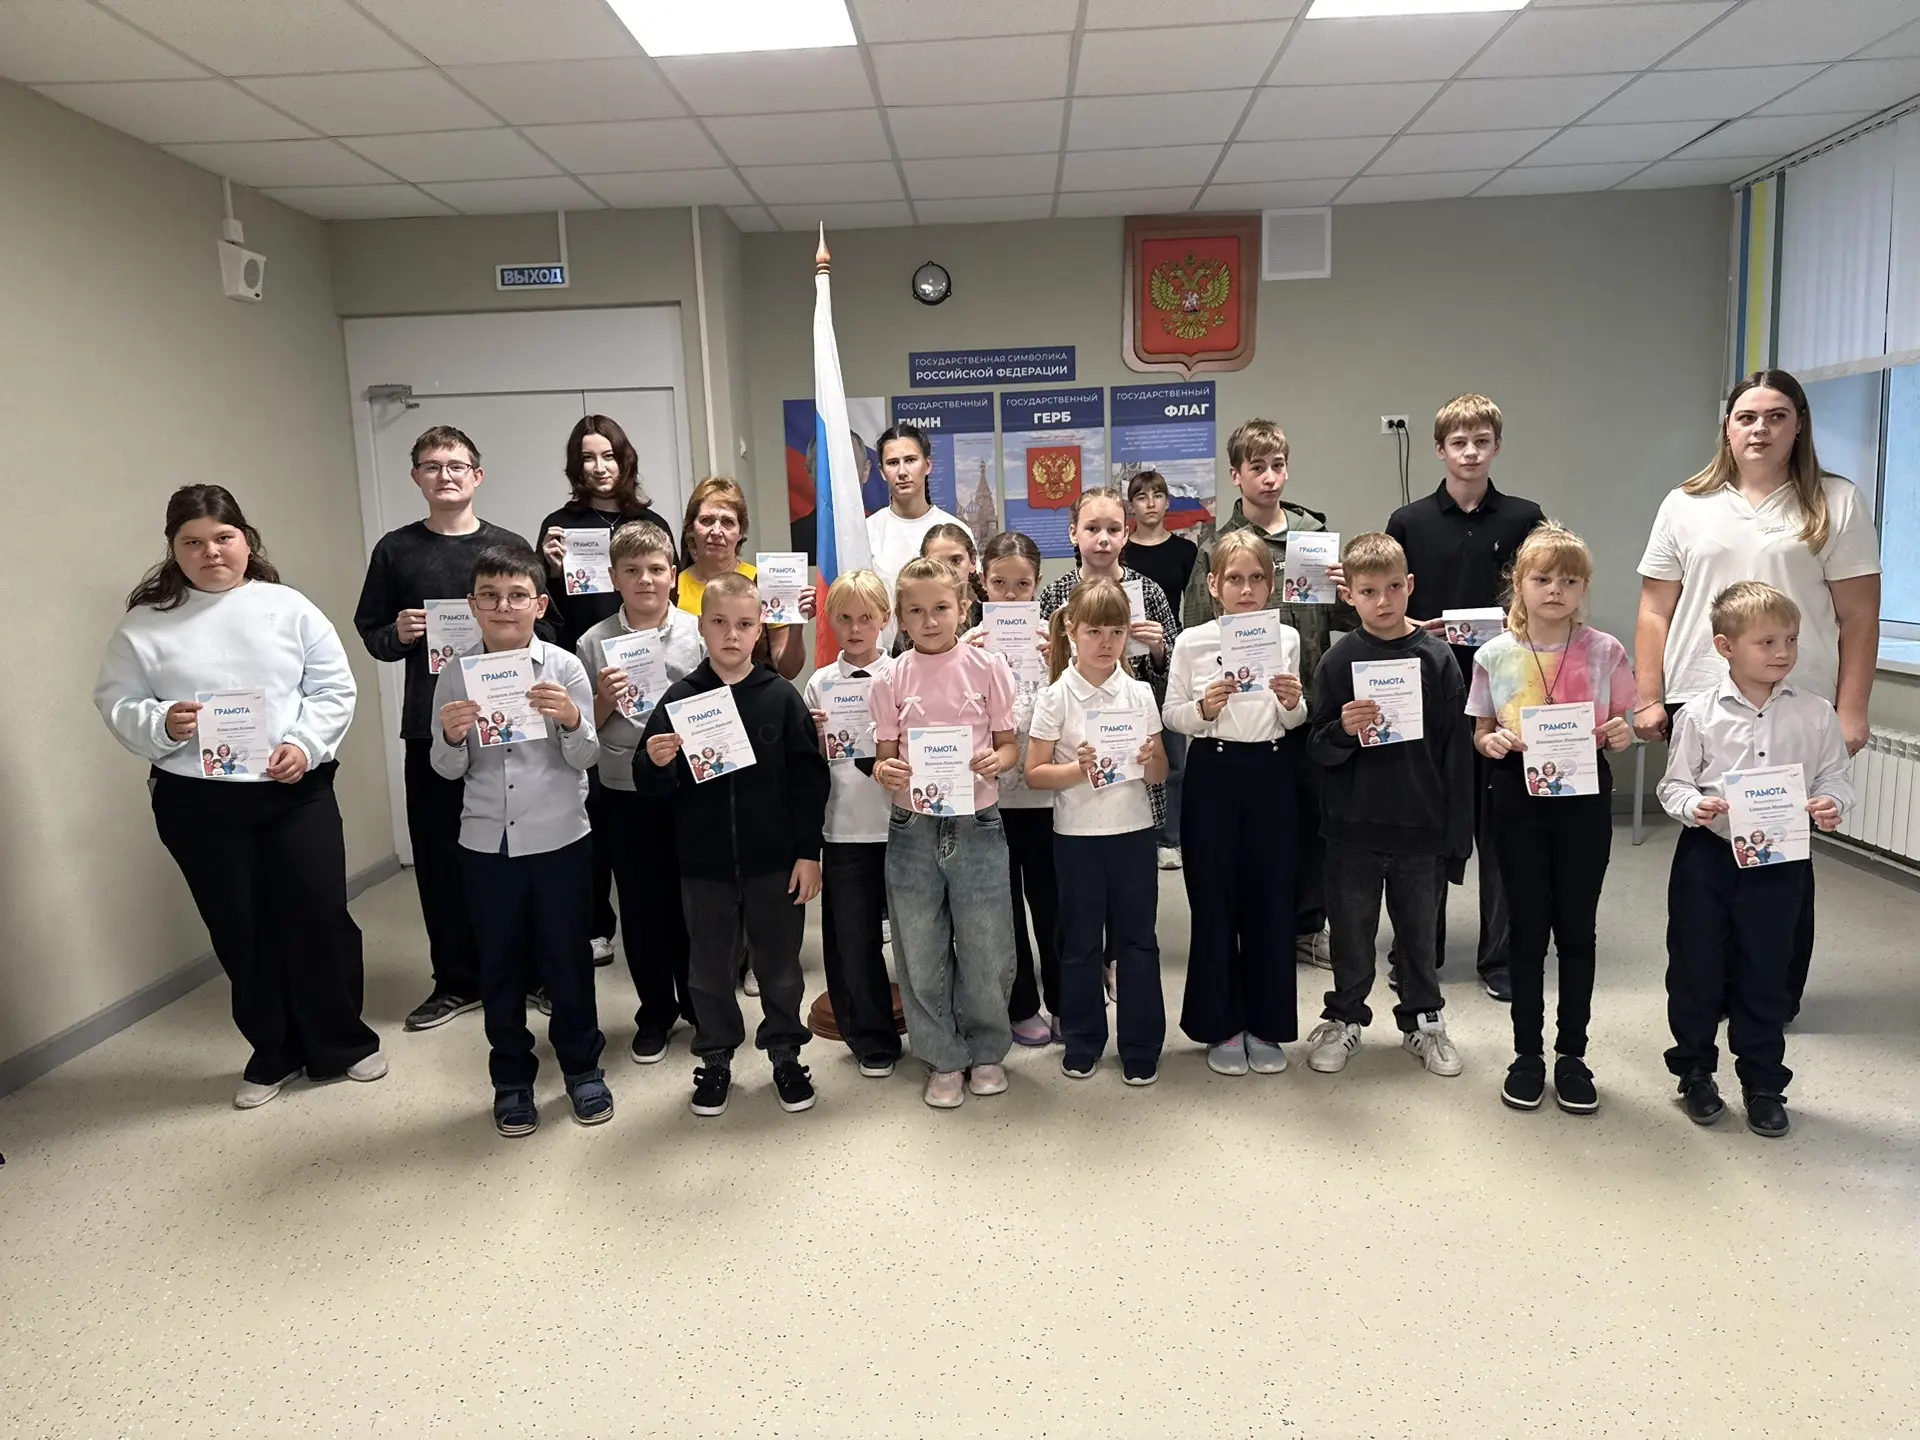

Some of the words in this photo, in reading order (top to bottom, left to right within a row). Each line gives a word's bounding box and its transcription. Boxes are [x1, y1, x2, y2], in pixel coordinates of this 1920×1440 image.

[503, 268, 562, 284] ВЫХОД
[915, 355, 1006, 367] ГОСУДАРСТВЕННАЯ
[1007, 352, 1068, 363] СИМВОЛИКА
[916, 367, 994, 381] РОССИЙСКОЙ
[996, 365, 1068, 378] ФЕДЕРАЦИИ
[1006, 393, 1098, 407] ГОСУДАРСТВЕННЫЙ
[1116, 387, 1210, 401] ГОСУДАРСТВЕННЫЙ
[897, 398, 988, 411] ГОСУДАРСТВЕННЫЙ
[1164, 403, 1209, 417] ФЛАГ
[1033, 411, 1072, 424] ГЕРБ
[996, 618, 1027, 626] ГРАМОТА
[1235, 627, 1267, 638] ГРАМОТА
[620, 647, 650, 660] ГРАМОТА
[481, 670, 519, 682] ГРАМОТА
[1369, 677, 1405, 686] ГРАМОТА
[214, 707, 251, 716] ГРАМОТА
[687, 708, 722, 724] ГРАМОТА
[1100, 724, 1133, 732] ГРАМОТА
[1538, 721, 1578, 731] ГРАМОТА
[924, 745, 958, 754] ГРАМОТА
[1744, 786, 1788, 799] ГРАМОТА
